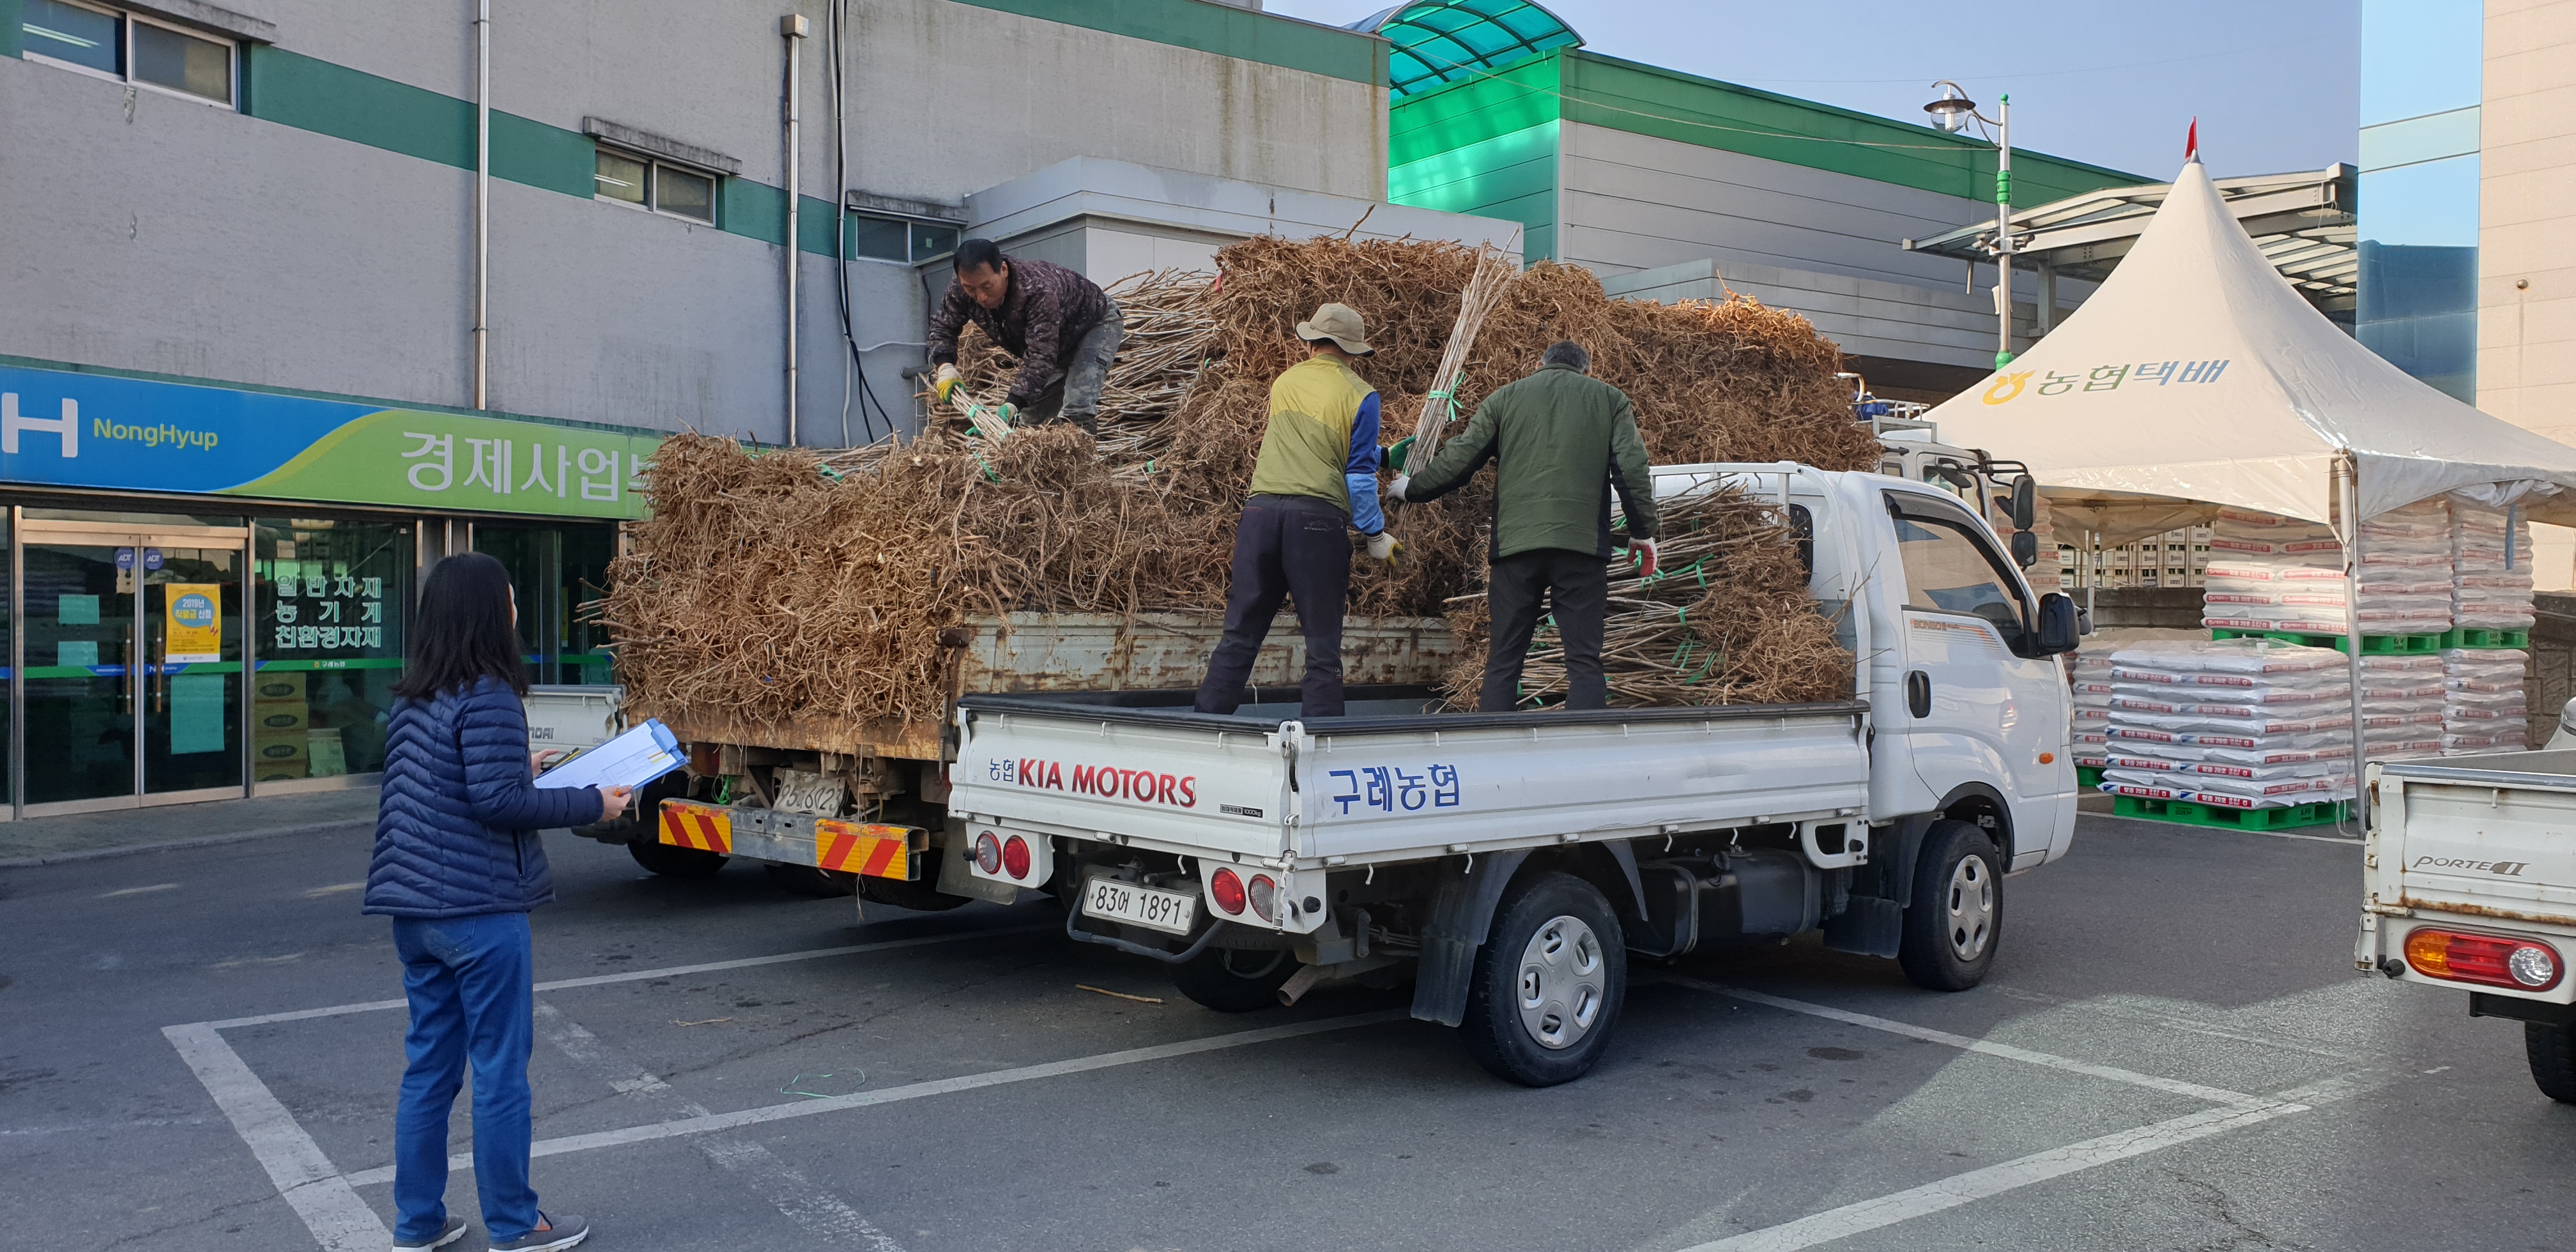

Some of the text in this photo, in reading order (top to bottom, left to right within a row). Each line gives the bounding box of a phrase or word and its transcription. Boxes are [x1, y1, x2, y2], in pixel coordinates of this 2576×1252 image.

[2037, 359, 2230, 395] 농협택배
[93, 418, 218, 451] NongHyup
[182, 599, 204, 607] 2019년
[277, 575, 381, 598] 일반자재
[275, 625, 381, 649] 친환경자재
[529, 726, 554, 739] NDAI
[990, 758, 1197, 809] 농협 KIA MOTORS
[1328, 764, 1459, 814] 구례농협
[1096, 885, 1181, 925] 83어 1891
